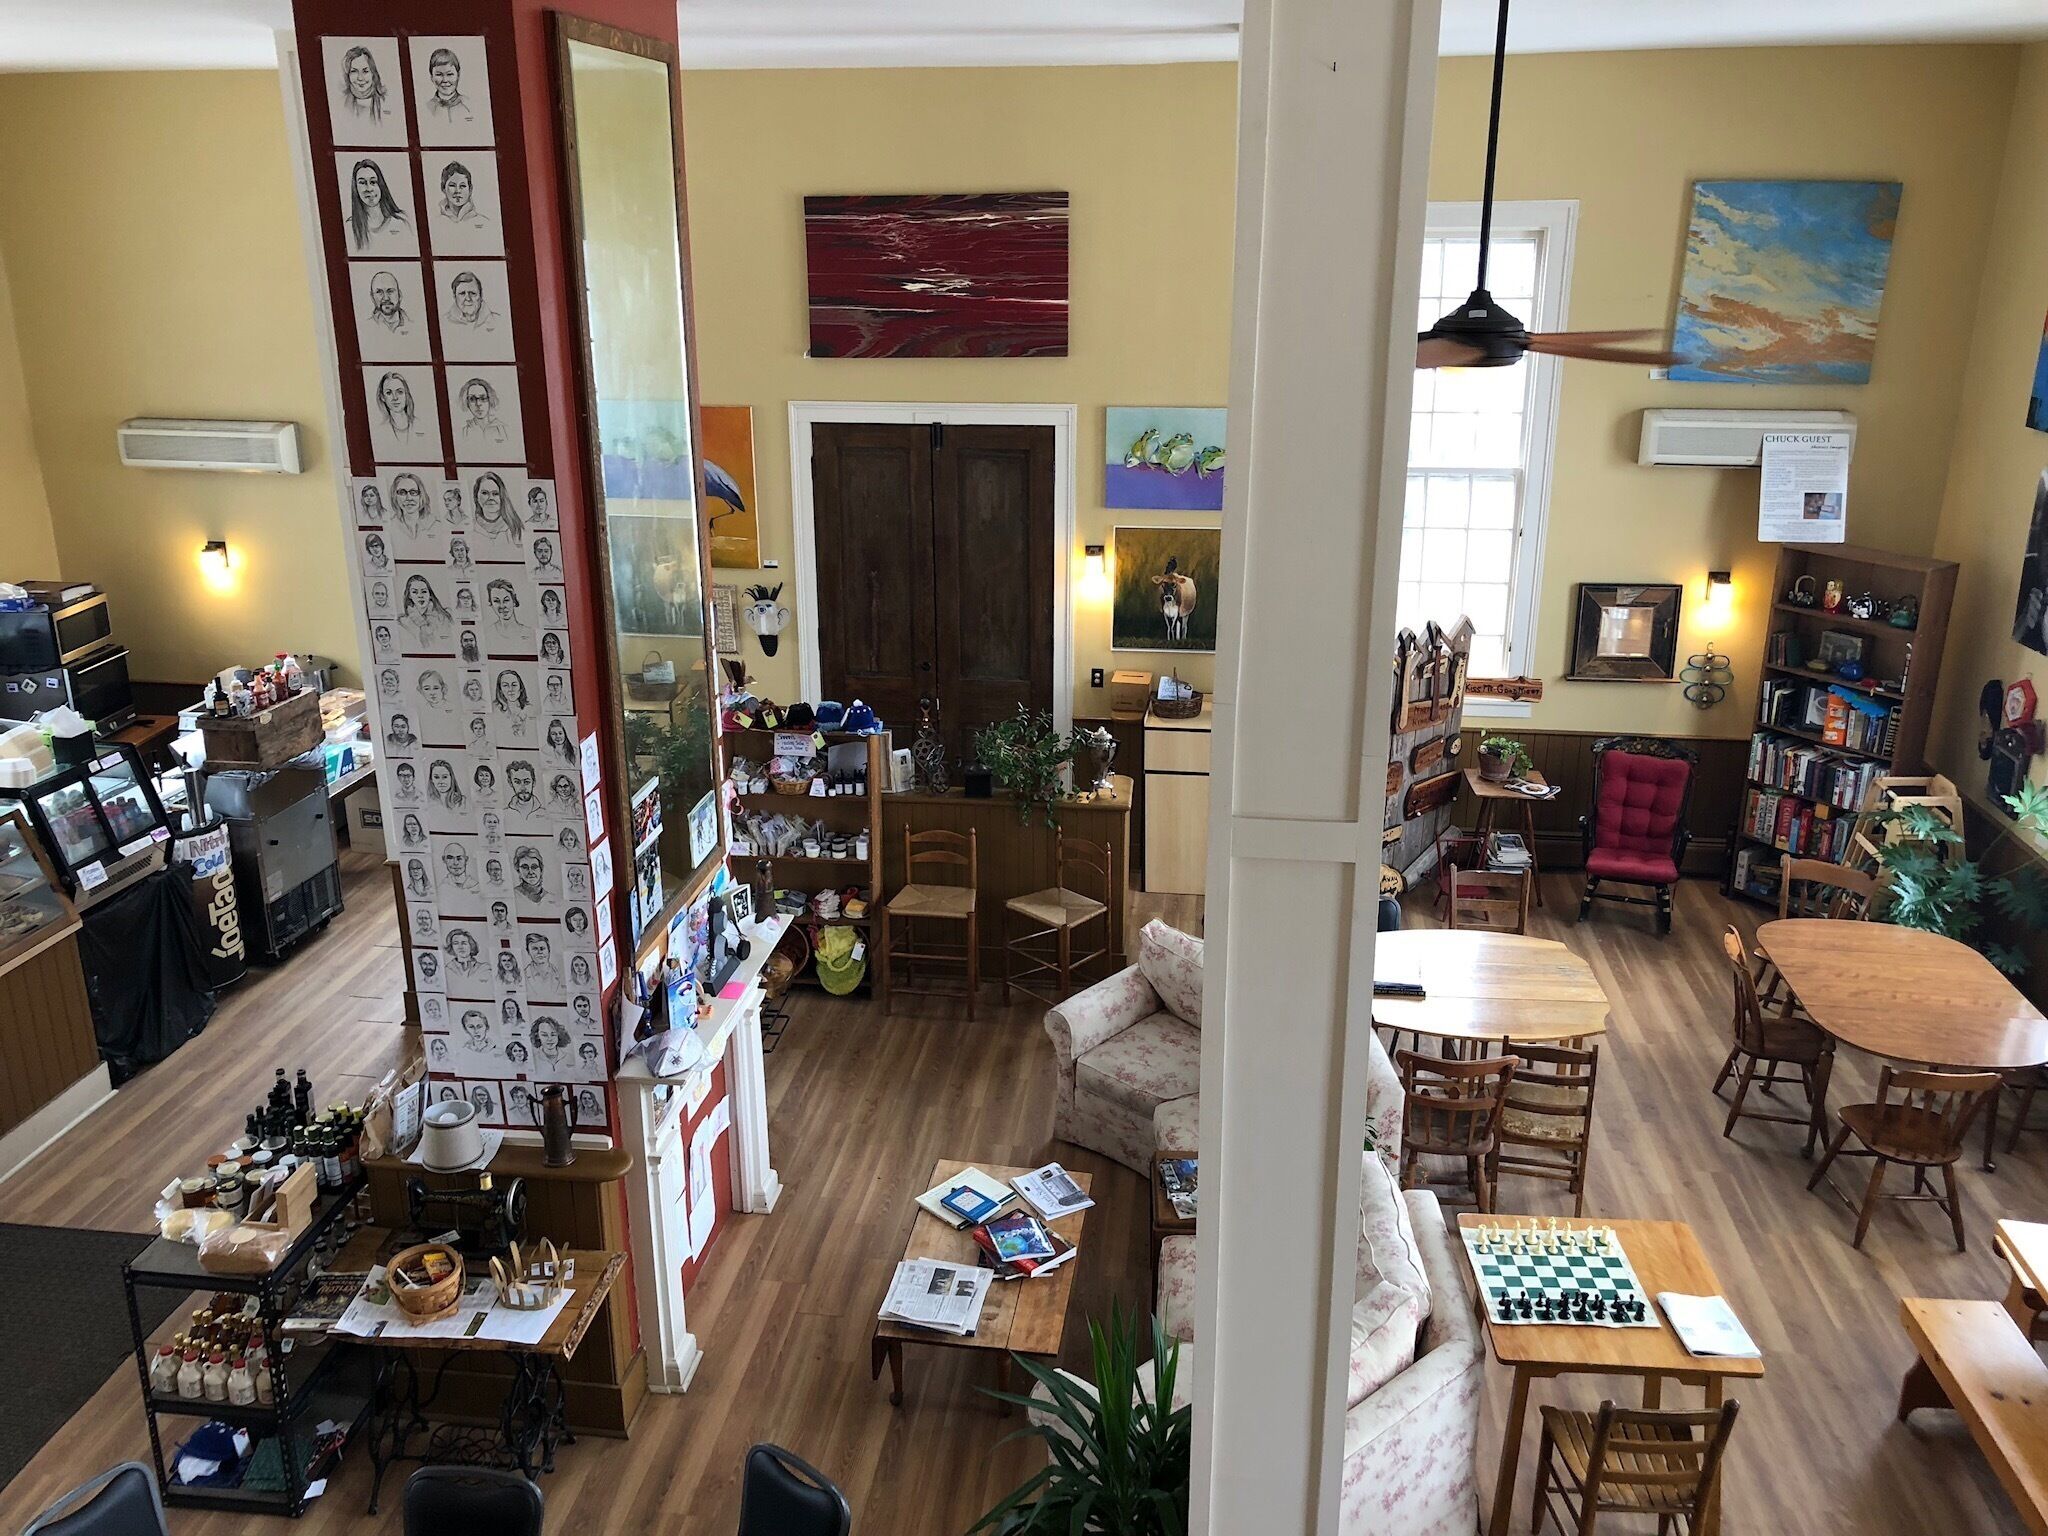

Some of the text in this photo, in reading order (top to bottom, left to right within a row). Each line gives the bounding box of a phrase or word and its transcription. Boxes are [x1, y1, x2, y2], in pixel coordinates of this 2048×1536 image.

[1765, 435, 1832, 443] CHUCK GUEST
[192, 850, 225, 877] Cold
